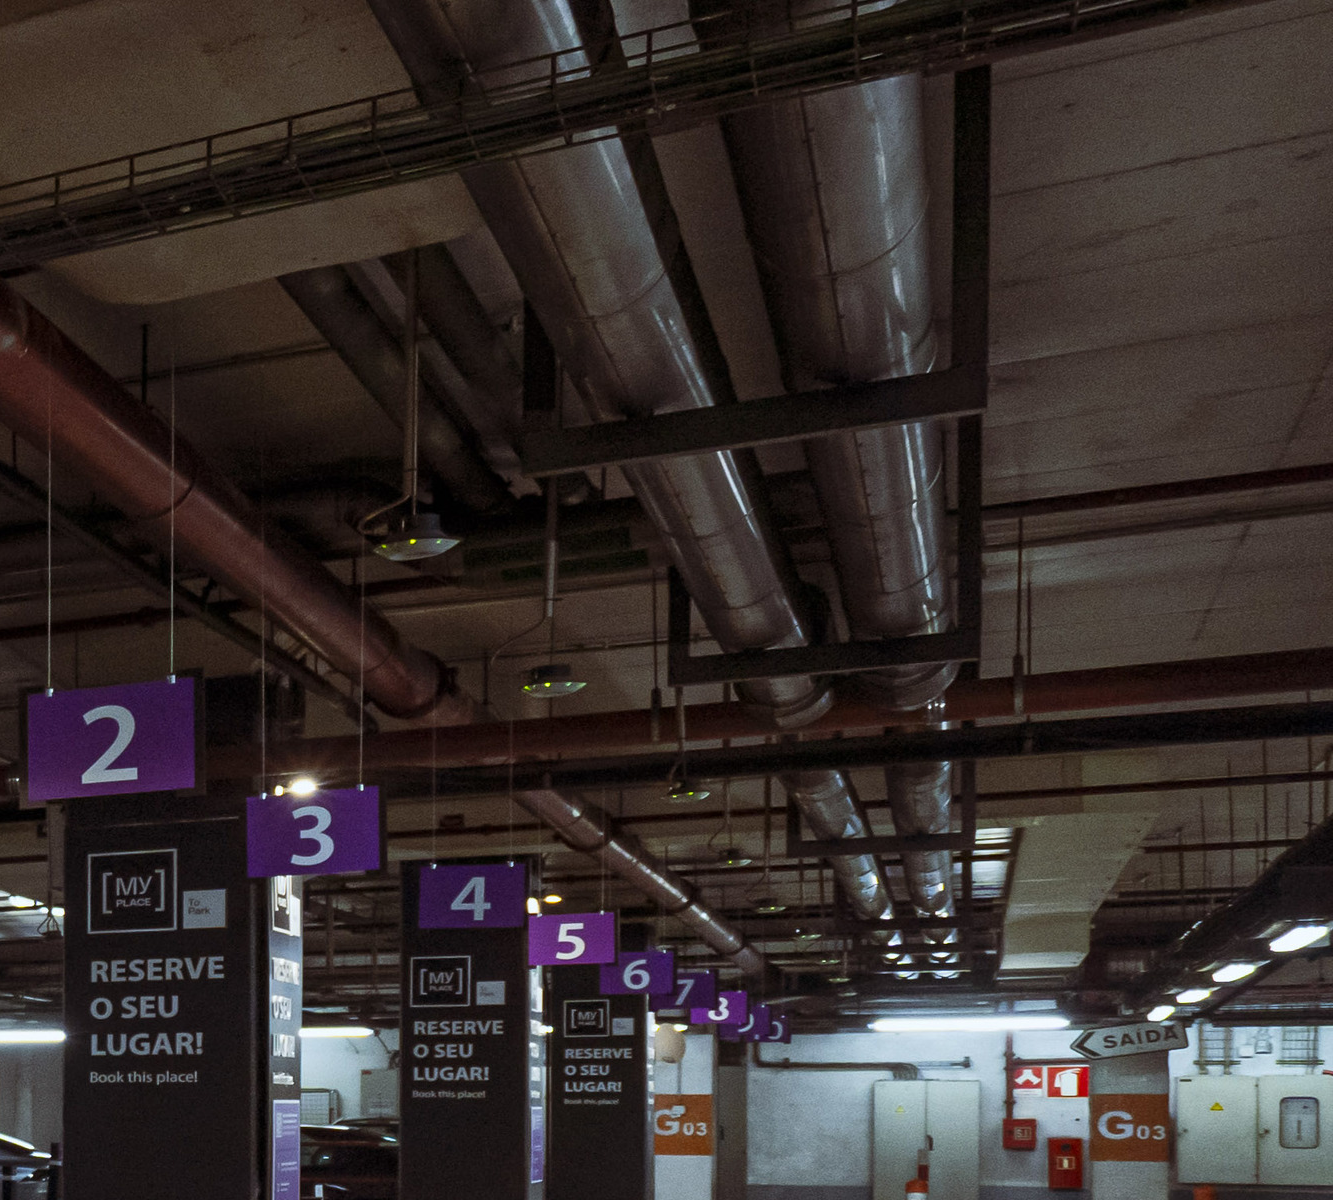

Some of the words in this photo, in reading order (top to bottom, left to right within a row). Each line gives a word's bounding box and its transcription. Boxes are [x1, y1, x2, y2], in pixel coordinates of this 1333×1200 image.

[81, 704, 138, 784] 2
[290, 805, 334, 866] 3
[116, 898, 152, 908] PLACE
[450, 876, 492, 921] 4
[555, 922, 586, 960] 5
[90, 955, 225, 983] RESERVE
[623, 959, 650, 990] 6
[675, 979, 695, 1006] 7
[90, 997, 113, 1020] O
[121, 995, 179, 1019] SEU
[413, 1020, 504, 1035] RESERVE
[1103, 1024, 1179, 1049] SAÍDA
[90, 1031, 204, 1056] LUGAR!
[412, 1043, 430, 1059] O
[433, 1043, 474, 1059] SEU
[564, 1047, 632, 1059] RESERVE
[89, 1070, 124, 1084] Book
[127, 1070, 153, 1084] this
[156, 1071, 198, 1086] place!
[413, 1066, 490, 1082] LUGAR!
[564, 1065, 577, 1076] O
[580, 1064, 610, 1076] SEU
[412, 1090, 436, 1098] Book
[564, 1081, 622, 1093] LUGAR!
[1097, 1110, 1166, 1141] G03
